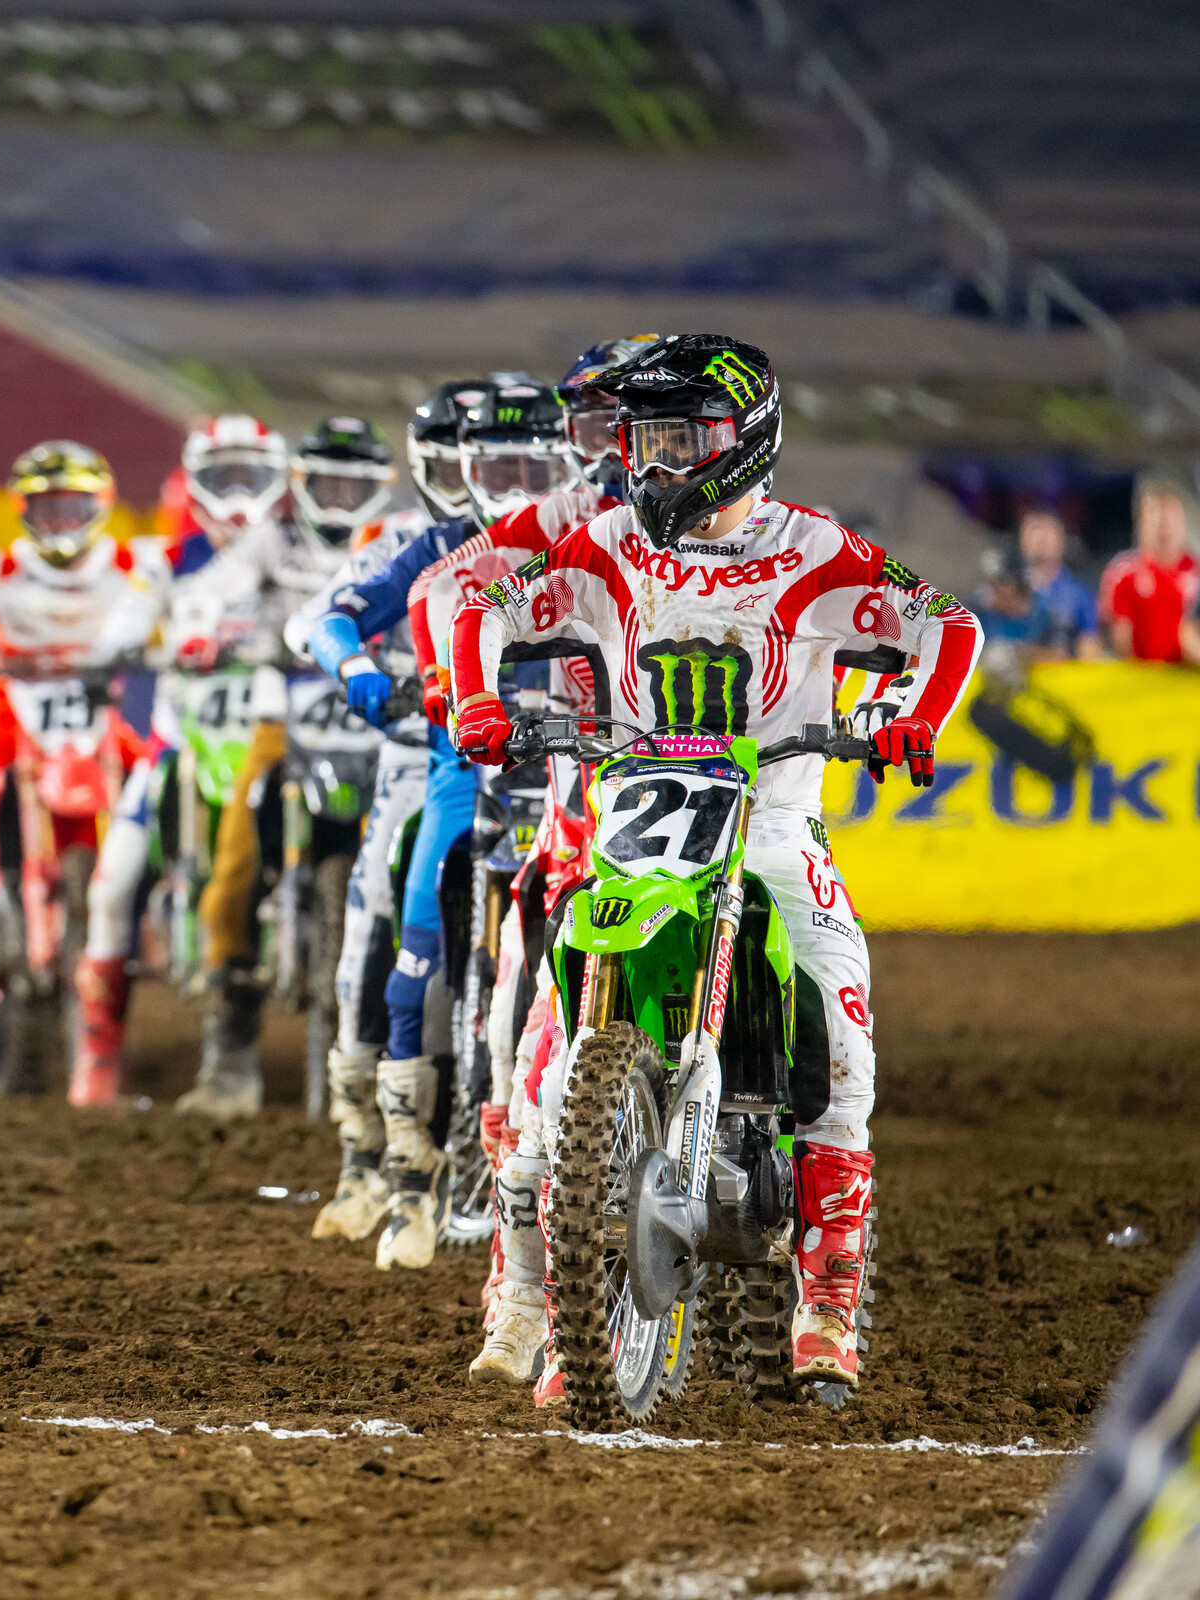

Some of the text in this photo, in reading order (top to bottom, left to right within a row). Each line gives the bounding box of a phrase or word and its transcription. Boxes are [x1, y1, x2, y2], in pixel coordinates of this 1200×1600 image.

[740, 376, 780, 433] SCO
[721, 438, 771, 486] MONSTER
[733, 453, 769, 487] ENERGY
[619, 533, 803, 596] Sixty years
[670, 541, 746, 557] Kawasaki
[501, 576, 527, 608] asaki
[904, 586, 938, 619] Kawas
[604, 778, 738, 866] 21
[690, 857, 732, 883] Kawasa
[734, 1093, 753, 1101] Twin
[682, 1102, 696, 1164] CARRILLO
[697, 1090, 714, 1200] DUNLOP
